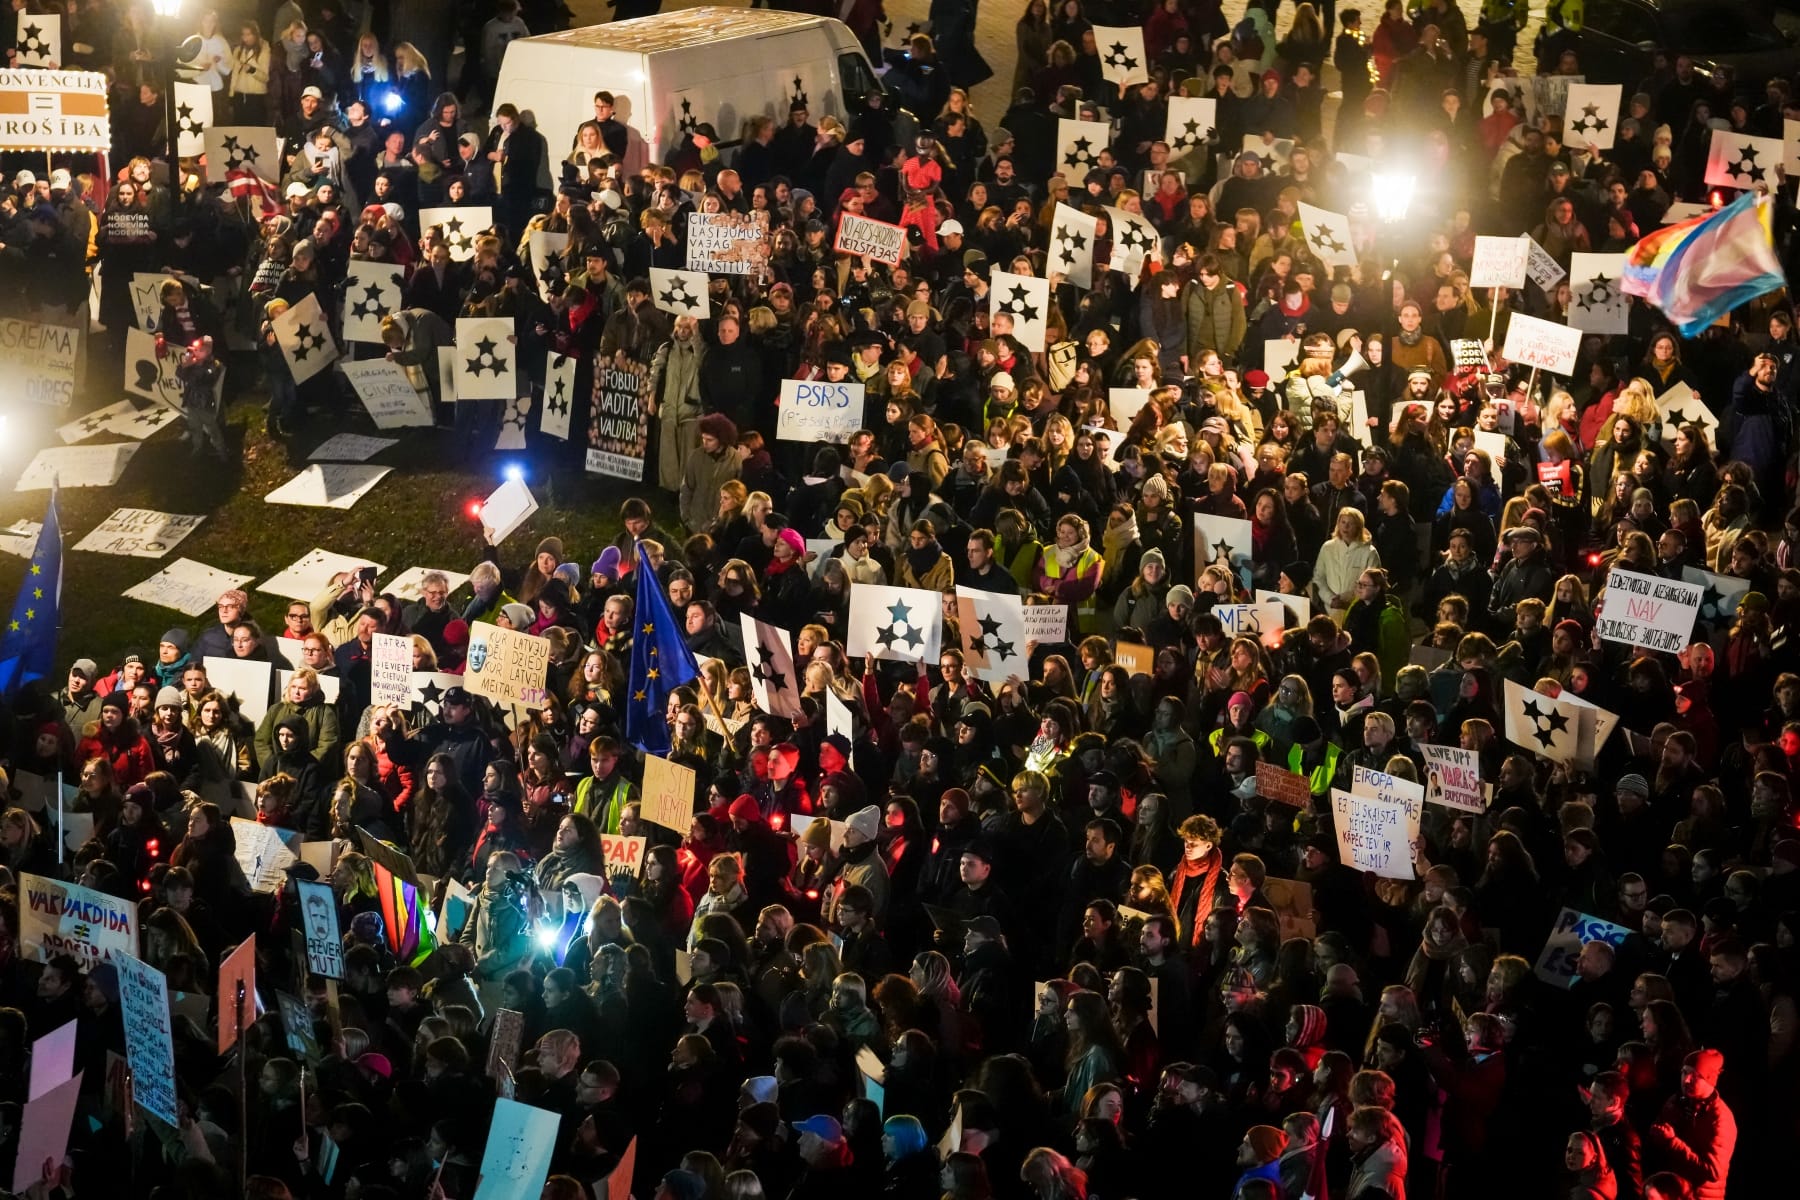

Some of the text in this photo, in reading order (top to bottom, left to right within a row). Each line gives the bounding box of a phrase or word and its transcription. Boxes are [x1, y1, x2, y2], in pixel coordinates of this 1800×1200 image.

[0, 74, 103, 90] ONVENCIJA
[0, 117, 101, 137] ROŠĪBA
[796, 384, 850, 408] PSRS
[1218, 605, 1260, 633] MĒS
[1626, 597, 1662, 621] NAV
[480, 677, 516, 698] MEITAS
[1426, 747, 1452, 762] LIVE
[1353, 767, 1393, 790] EIROPA
[602, 840, 640, 864] PAR
